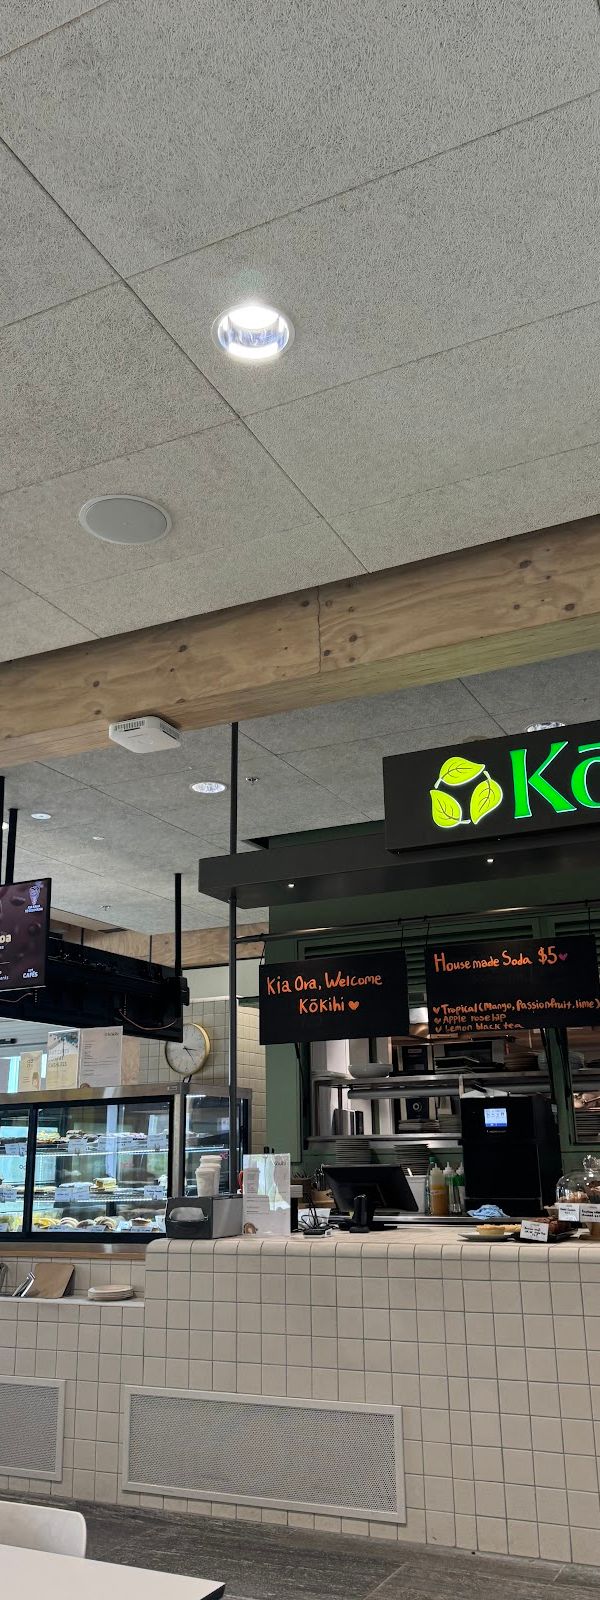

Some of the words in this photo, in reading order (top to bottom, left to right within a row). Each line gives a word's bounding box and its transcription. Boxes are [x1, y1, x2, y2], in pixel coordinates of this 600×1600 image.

[502, 950, 533, 966] Soda
[537, 945, 558, 965] $5
[266, 975, 292, 996] Kia
[294, 975, 322, 992] Ora,
[324, 970, 383, 989] Welcome
[443, 1014, 467, 1024] Apple
[445, 1024, 473, 1033] Lemon
[475, 1022, 501, 1031] black
[503, 1021, 524, 1030] tea
